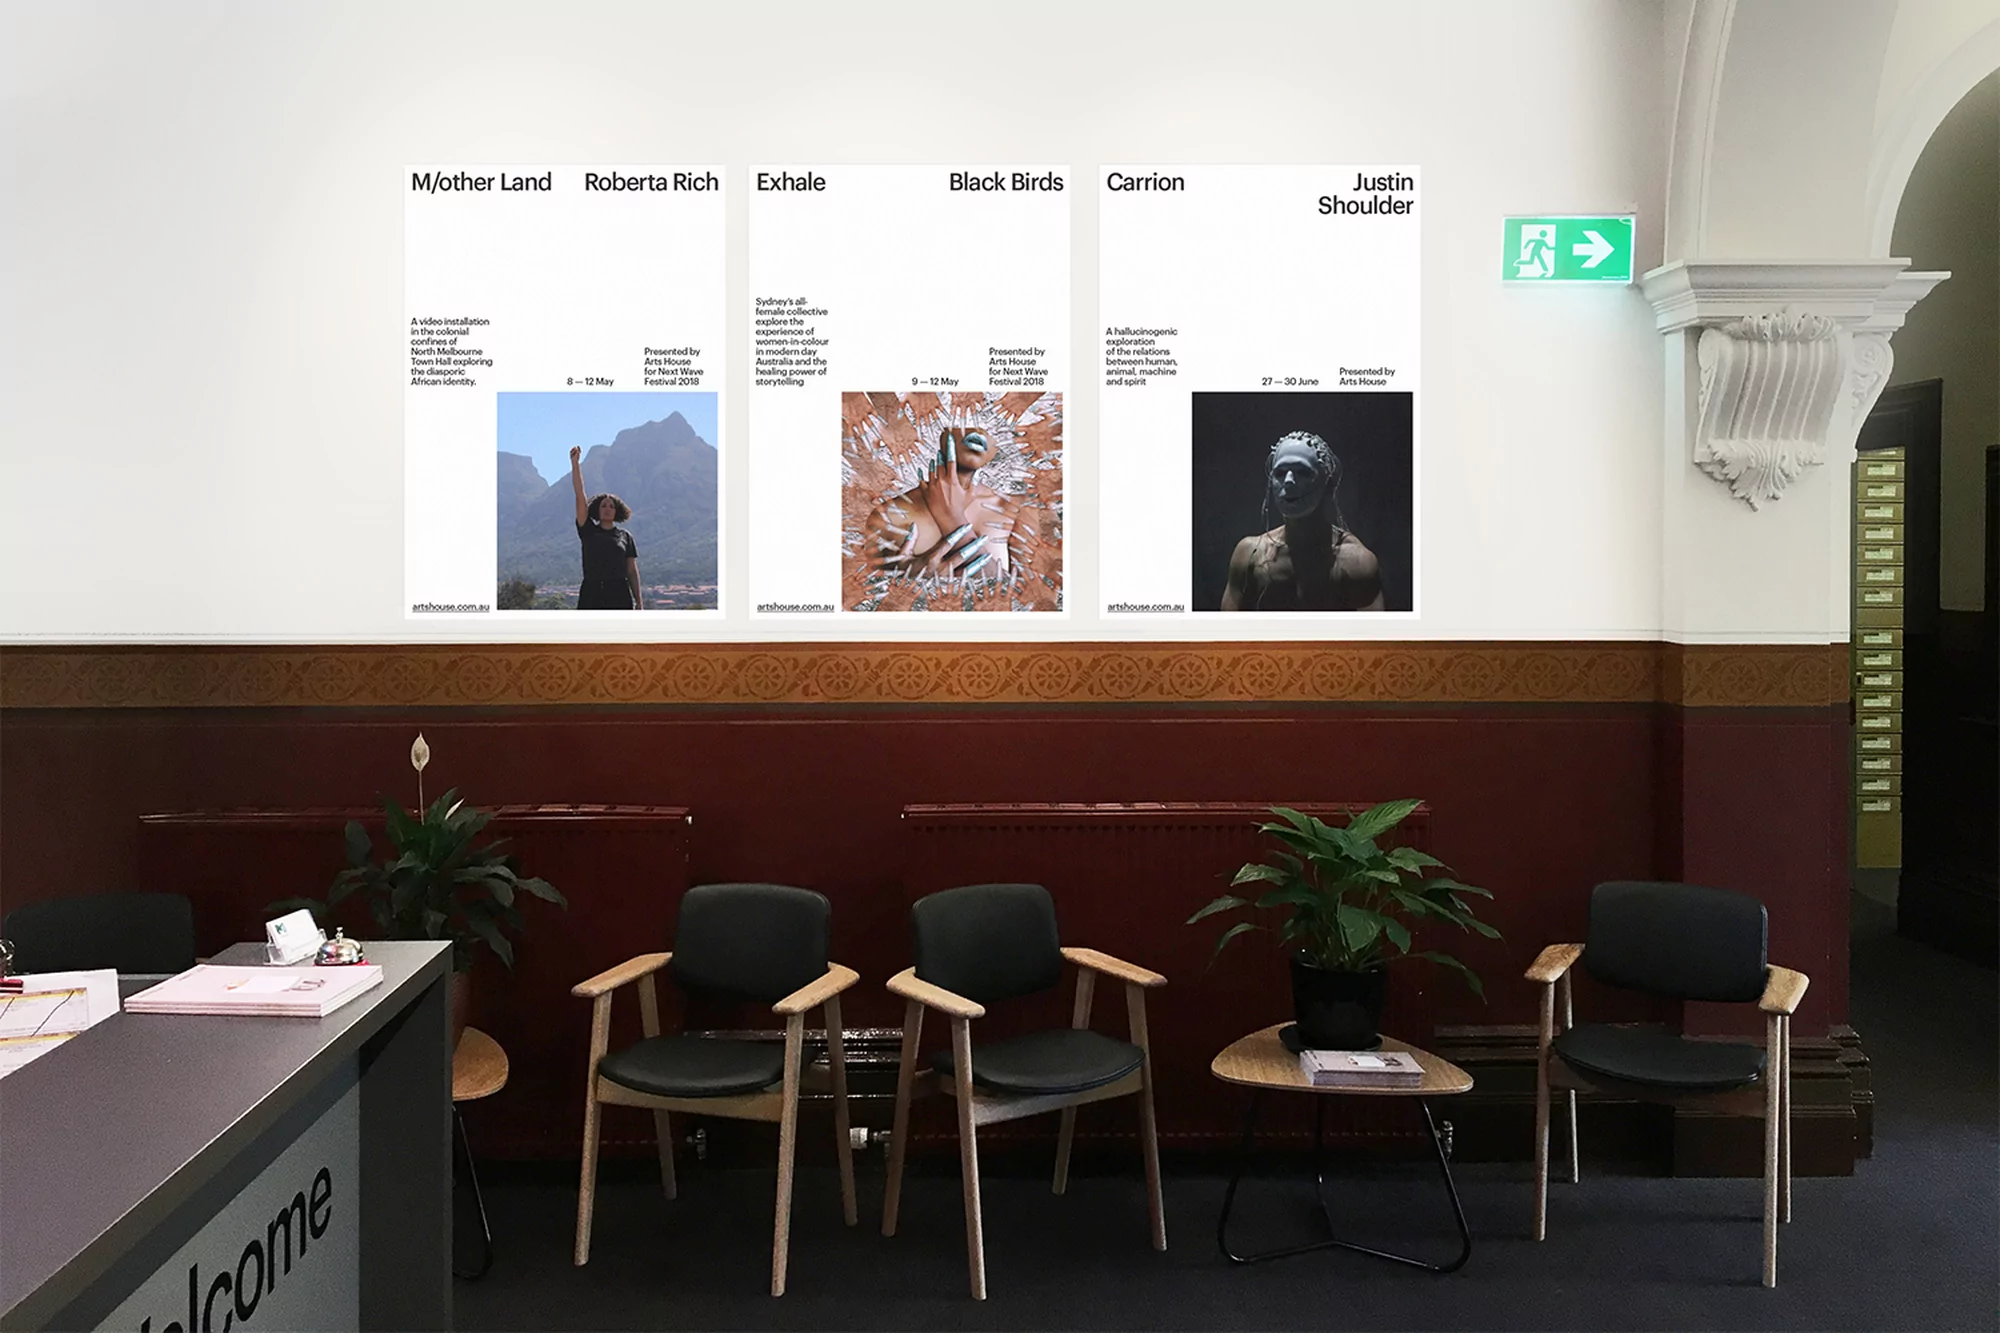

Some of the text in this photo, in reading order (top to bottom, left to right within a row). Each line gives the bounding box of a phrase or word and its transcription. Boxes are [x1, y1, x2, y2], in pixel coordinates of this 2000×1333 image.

[413, 171, 551, 194] M/other Land
[585, 171, 718, 191] Roberta Rich
[758, 171, 826, 191] Exhale
[950, 171, 1064, 191] Black Birds
[1107, 172, 1184, 191] Carrion
[1353, 172, 1413, 191] Justin
[1318, 195, 1414, 215] Shoulder
[795, 296, 808, 305] all-
[756, 306, 828, 315] female collective
[411, 316, 490, 325] A video installation
[756, 316, 804, 328] explore the
[411, 326, 469, 335] in the colonial
[756, 326, 814, 338] experience of
[1106, 326, 1177, 338] A hallucinogenic
[411, 336, 457, 345] confines of
[756, 336, 829, 345] women-in-colour
[1106, 336, 1155, 348] exploration
[411, 347, 483, 355] North Melbourne
[644, 347, 700, 358] Presented by
[756, 347, 817, 358] in modern day
[989, 347, 1045, 358] Presented by
[1106, 347, 1170, 355] of the relations
[411, 357, 493, 368] Town Hall exploring
[644, 357, 691, 365] Arts House
[756, 357, 827, 365] Australia and the
[989, 357, 1036, 365] Arts House
[1106, 357, 1177, 368] between human,
[411, 367, 465, 378] the diasporic
[644, 367, 704, 375] for Next Wave
[756, 367, 827, 378] healing power of
[989, 367, 1048, 375] for Next Wave
[1106, 367, 1176, 378] animal, machine
[1340, 367, 1395, 378] Presented by
[411, 377, 476, 388] African identity.
[567, 377, 573, 386] 8
[585, 377, 594, 386] 12
[596, 377, 614, 388] May
[644, 377, 699, 386] Festival 2018
[756, 377, 804, 388] storytelling
[912, 377, 918, 386] 9
[930, 377, 939, 386] 12
[941, 377, 959, 388] May
[989, 377, 1044, 386] Festival 2018
[1106, 377, 1146, 388] and spirit
[1262, 377, 1272, 386] 27
[1284, 377, 1296, 386] 30
[1298, 377, 1319, 386] June
[1339, 377, 1387, 386] Arts House
[412, 602, 490, 613] artshouse.com.au
[757, 602, 834, 612] artshouse.com.au
[1108, 602, 1184, 613] artshouse.com.au
[141, 1166, 332, 1333] lcome
